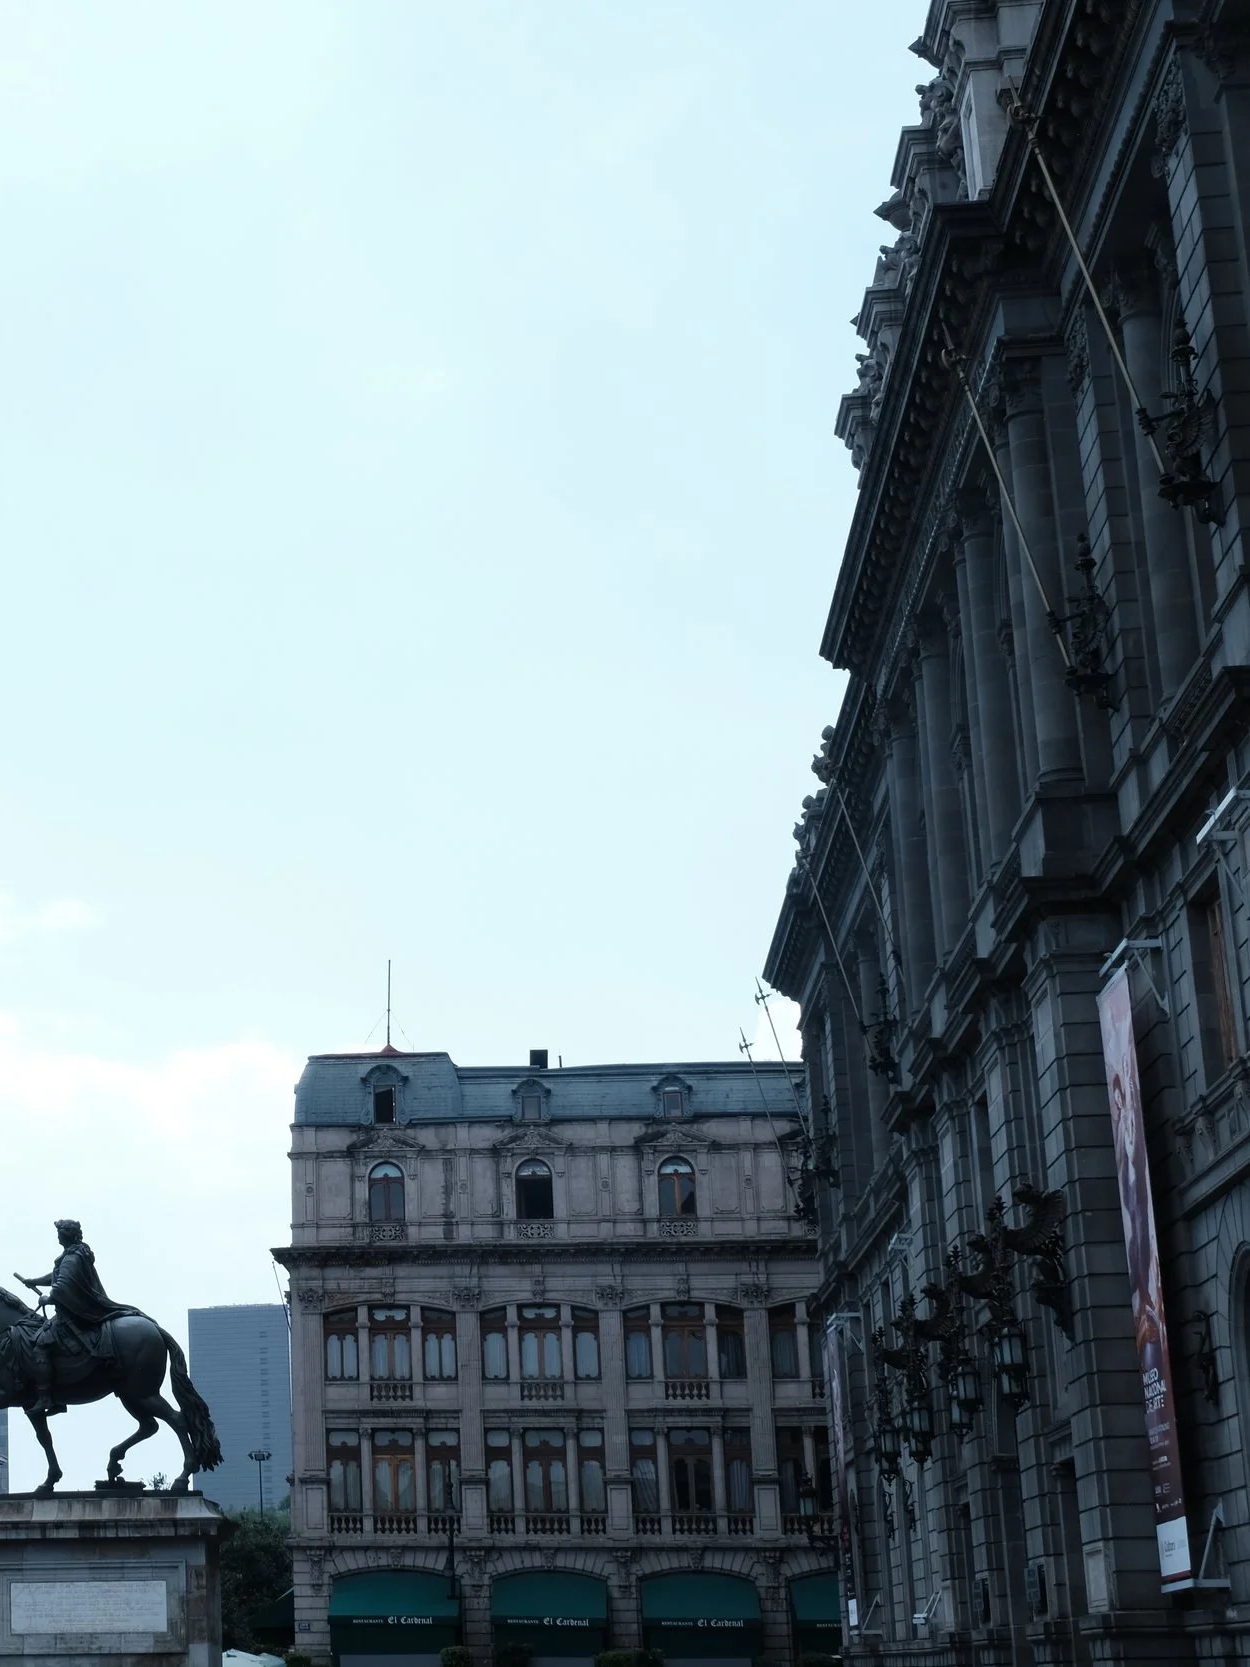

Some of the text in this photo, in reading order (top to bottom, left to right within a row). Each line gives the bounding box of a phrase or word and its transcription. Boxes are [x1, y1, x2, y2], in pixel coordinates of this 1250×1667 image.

[1142, 1367, 1159, 1386] MUSEO
[387, 1616, 397, 1624] El
[400, 1616, 433, 1625] Cardenal
[543, 1617, 553, 1625] El
[556, 1618, 590, 1627] Cardenal
[697, 1619, 707, 1627] El
[710, 1619, 744, 1627] Cardenal
